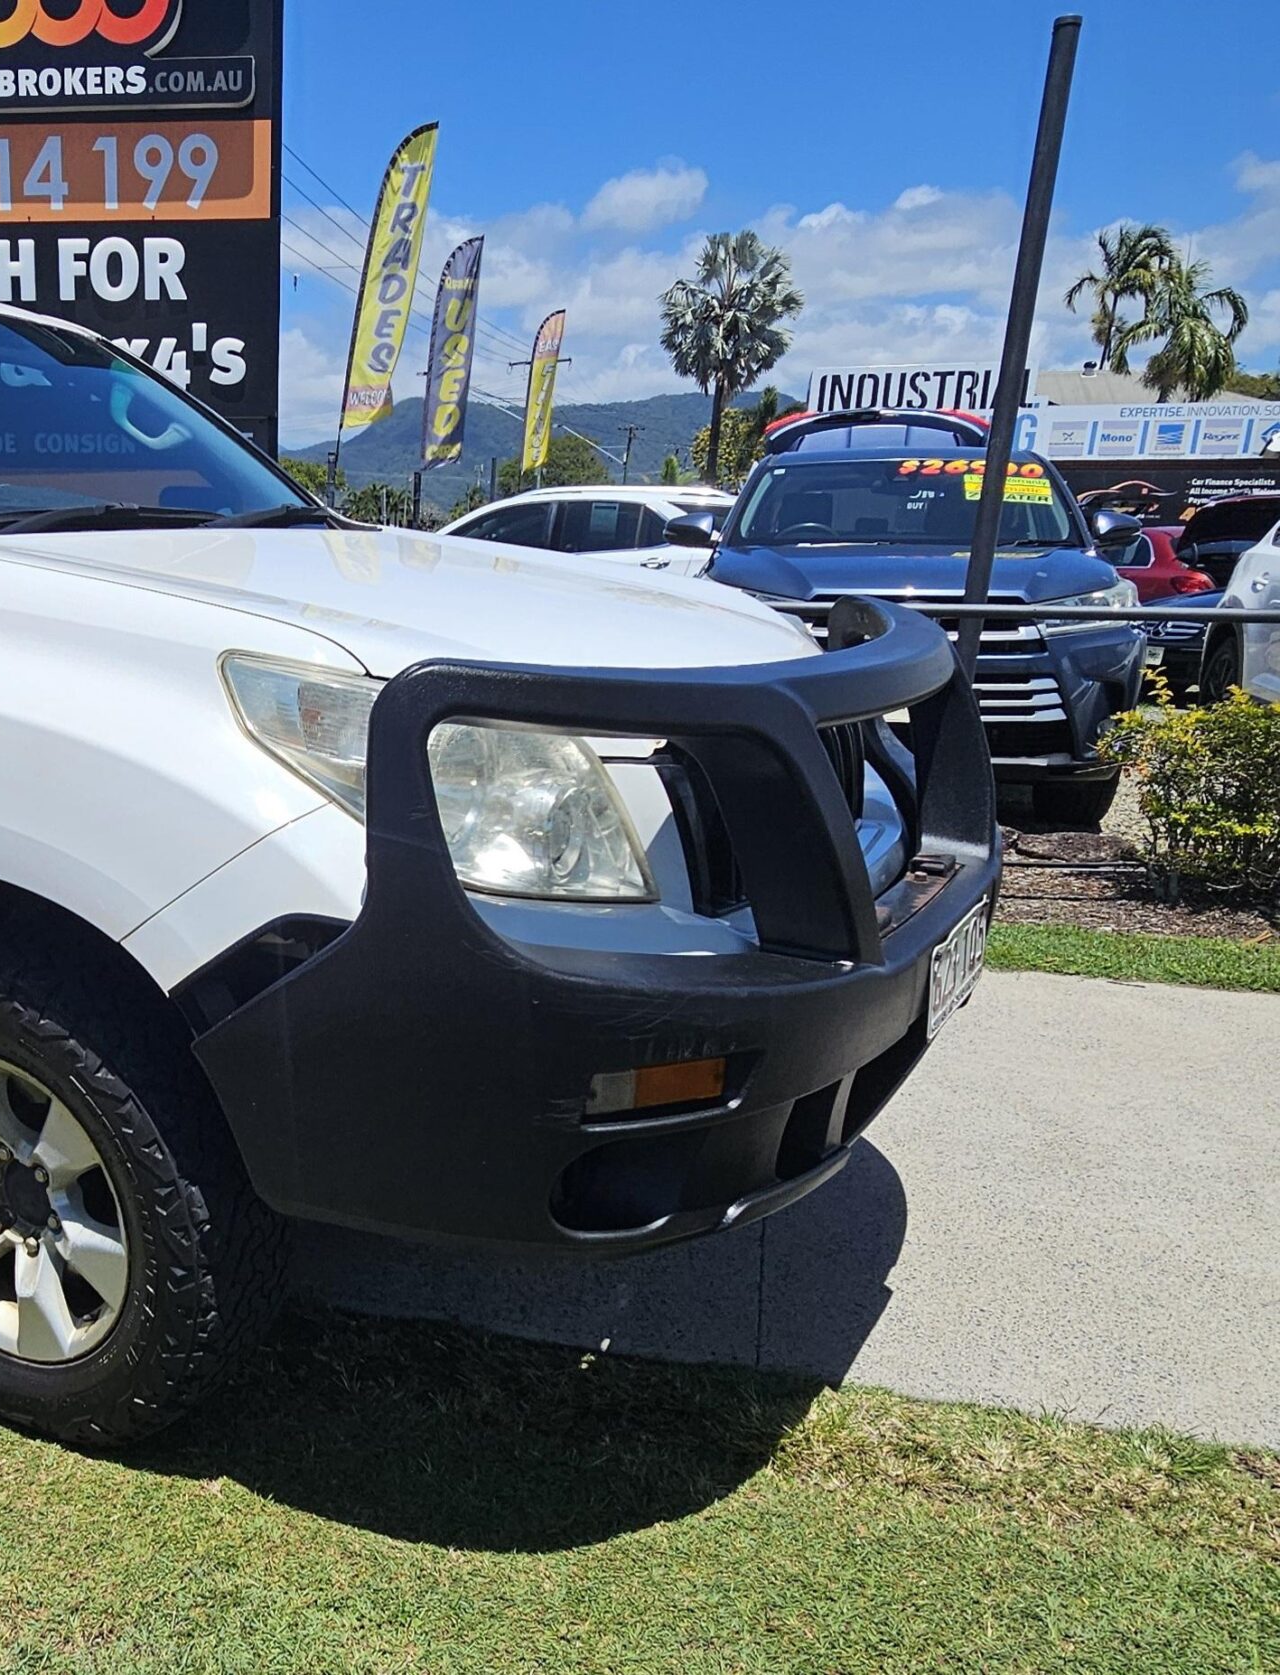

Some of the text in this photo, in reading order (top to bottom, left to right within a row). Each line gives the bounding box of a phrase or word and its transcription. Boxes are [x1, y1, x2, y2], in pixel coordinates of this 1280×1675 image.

[92, 133, 219, 210] 199
[57, 237, 187, 301] FOR
[368, 164, 426, 373] TRADES
[436, 297, 471, 436] USED
[817, 369, 1033, 413] INDUSTRIL
[1100, 433, 1133, 443] Mono
